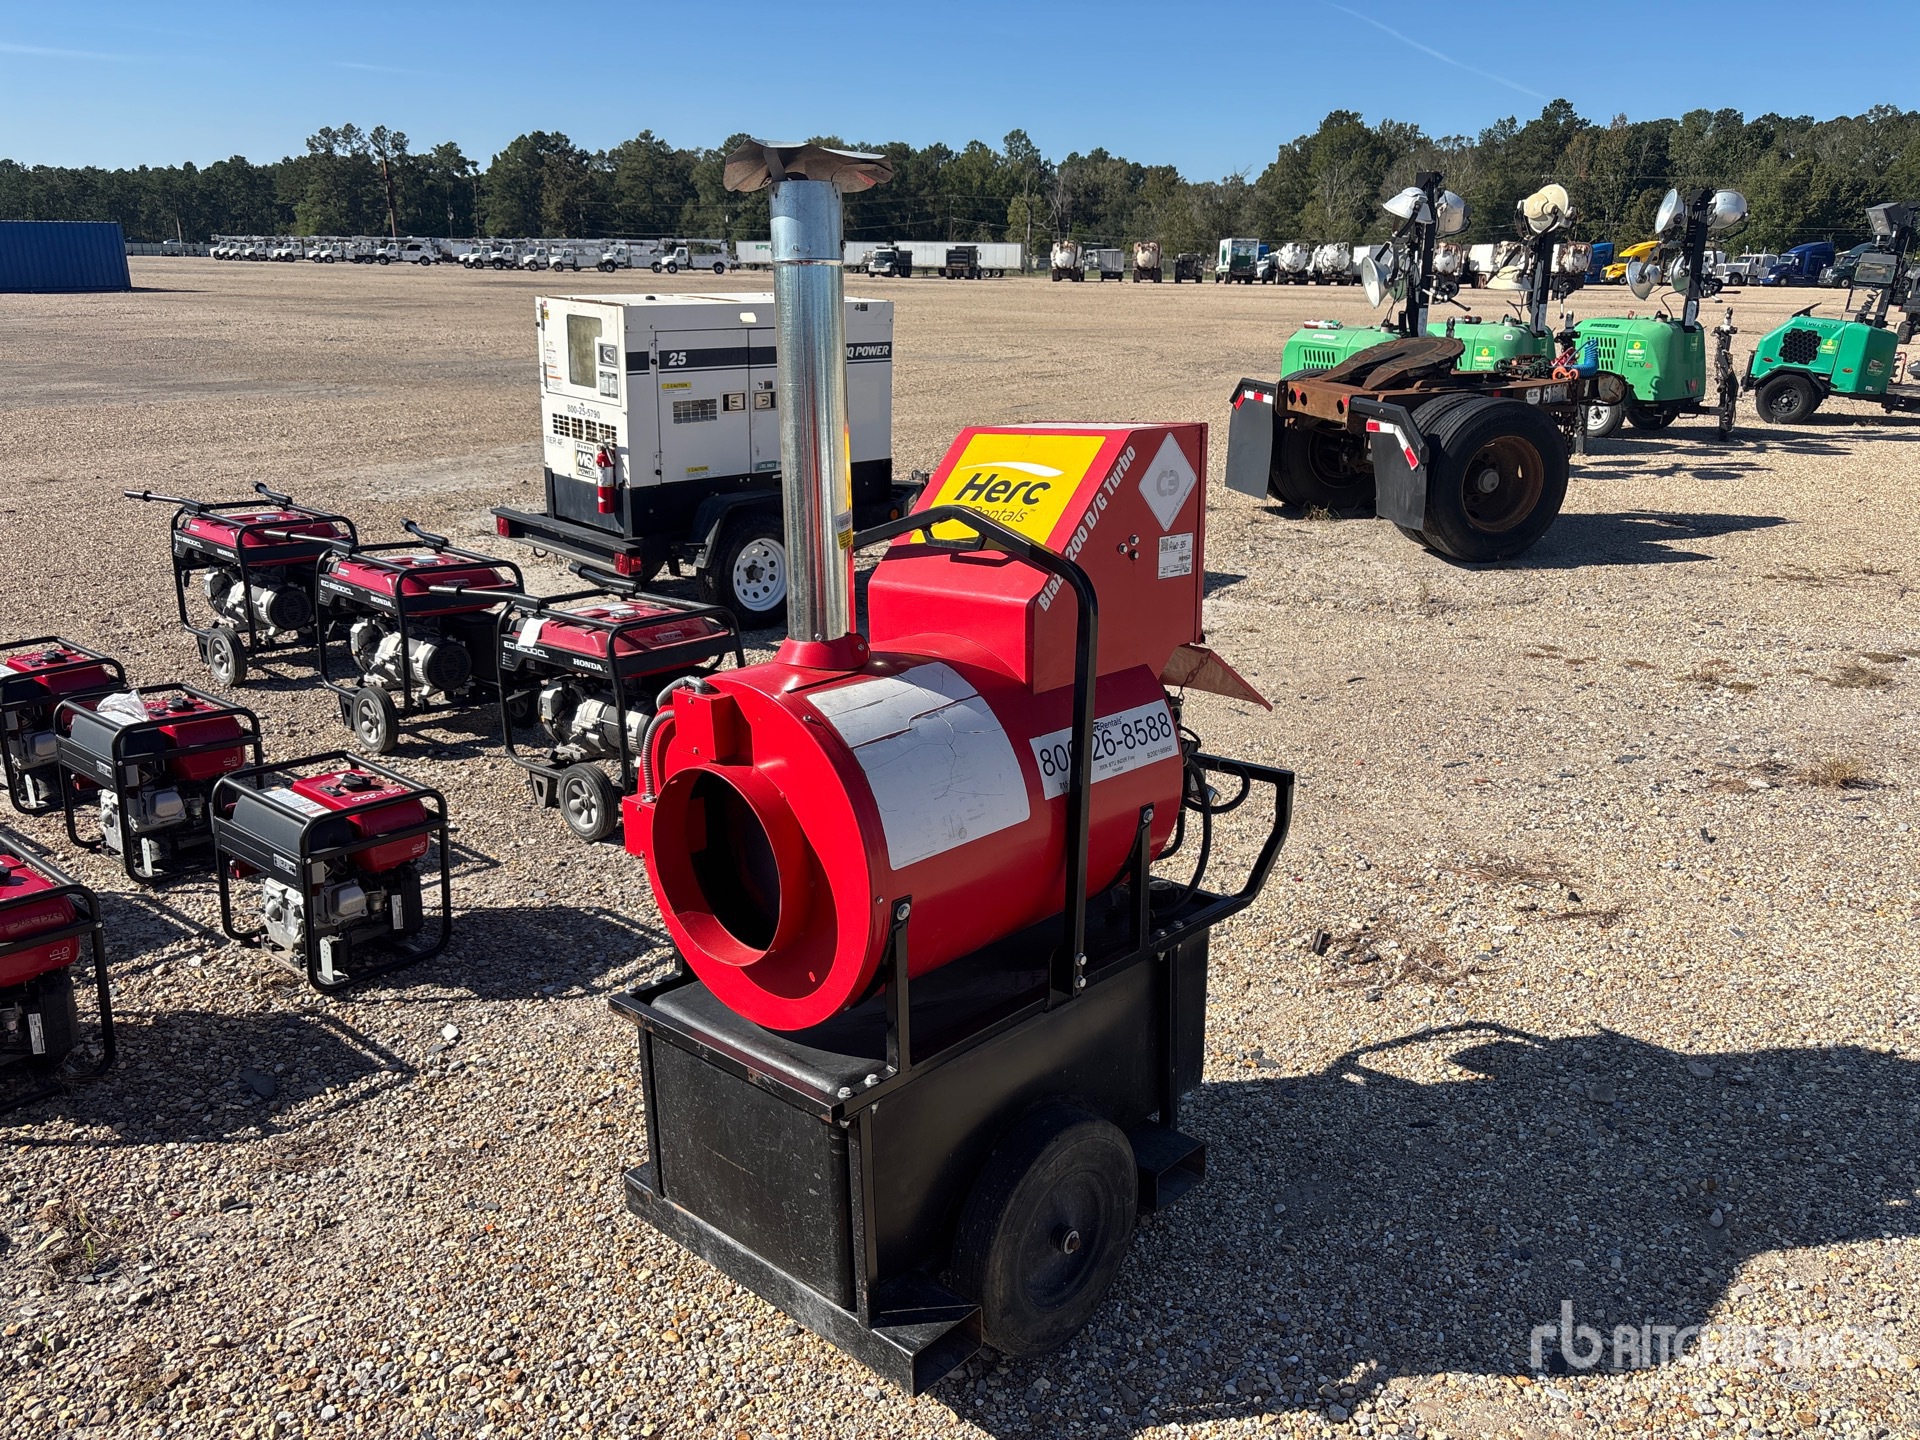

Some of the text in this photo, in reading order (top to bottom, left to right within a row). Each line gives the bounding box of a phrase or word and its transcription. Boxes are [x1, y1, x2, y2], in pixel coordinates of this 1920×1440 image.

[855, 345, 890, 357] POWER
[668, 352, 687, 366] 25
[953, 472, 1051, 505] Herc
[1037, 445, 1137, 612] Blaz 200 D/G Turbo
[370, 595, 393, 608] HONDA
[572, 658, 604, 672] HONDA
